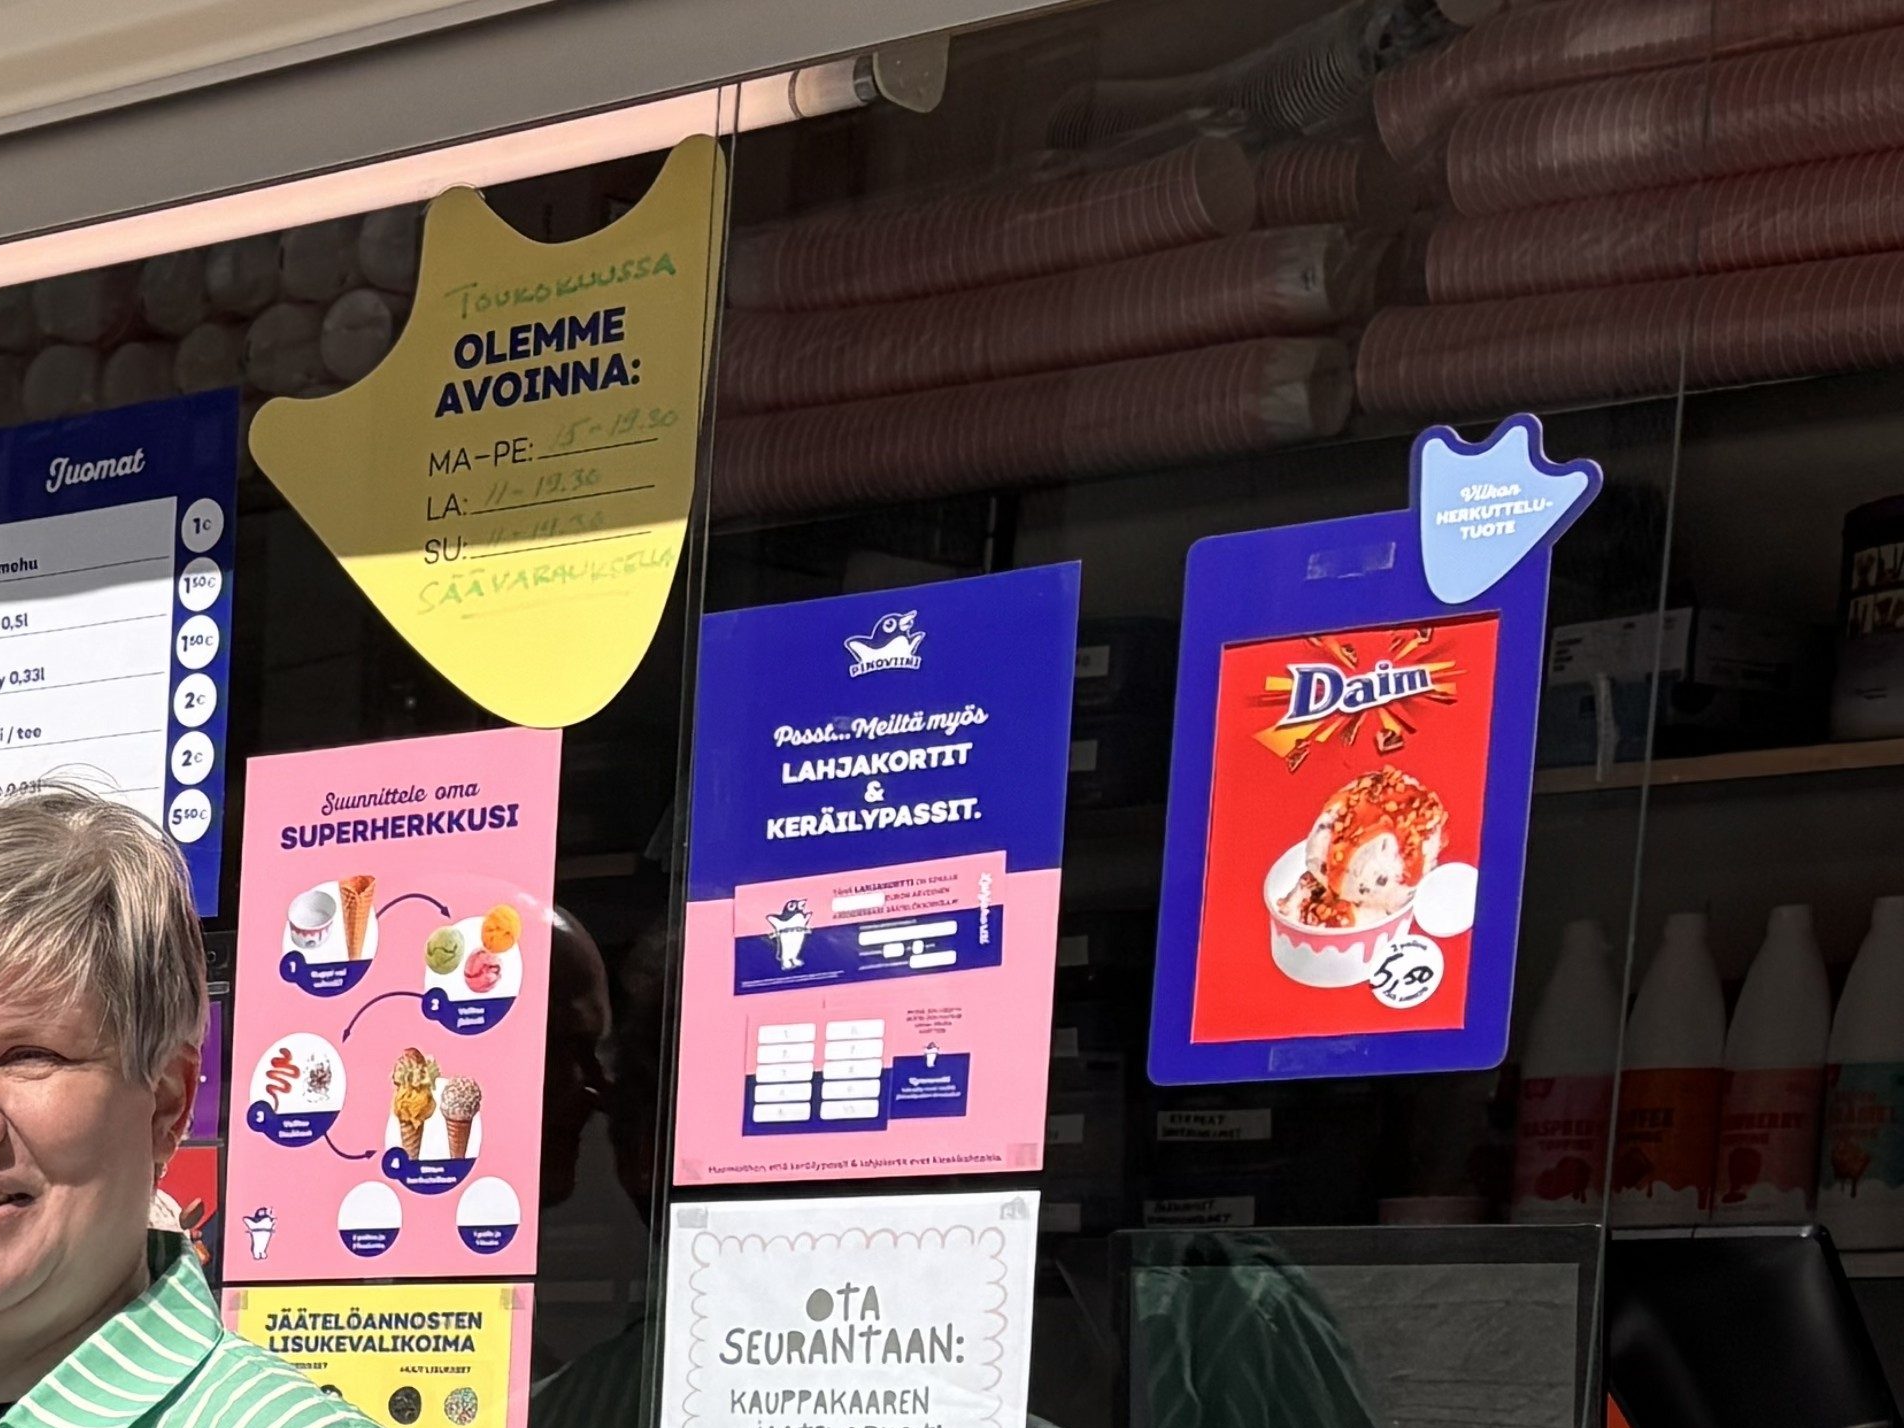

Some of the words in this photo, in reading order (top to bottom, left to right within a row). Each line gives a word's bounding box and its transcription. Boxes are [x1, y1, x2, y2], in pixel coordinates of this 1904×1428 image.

[444, 252, 678, 321] TOUKOKUUSSA
[454, 306, 628, 371] OLEMME
[434, 357, 643, 419] AVOINNA:
[46, 448, 146, 493] Juomat
[426, 493, 468, 521] LA:
[1460, 482, 1522, 501] Viikon
[1435, 497, 1555, 526] HERKUTTELU-
[1459, 518, 1517, 539] TUOTE
[424, 536, 468, 564] SU:
[1282, 660, 1436, 727] Daim
[16, 726, 43, 741] tee
[926, 704, 990, 736] myös
[782, 742, 974, 785] LAHJAKORTIT
[321, 784, 427, 817] Suunnittele
[434, 780, 481, 802] oma
[863, 780, 885, 803] &
[280, 803, 520, 852] SUPERHERKKUSI
[766, 796, 982, 841] KERÄILYPASSIT.
[289, 961, 296, 973] 1
[391, 1158, 400, 1169] 4
[806, 1281, 882, 1323] OTA
[265, 1306, 483, 1332] JÄÄTELÖANNOSTEN
[269, 1334, 476, 1354] LISUKEVALIKOIMA
[718, 1322, 968, 1367] SEURANTAAN:
[730, 1386, 930, 1418] KAUPPAKAAREN
